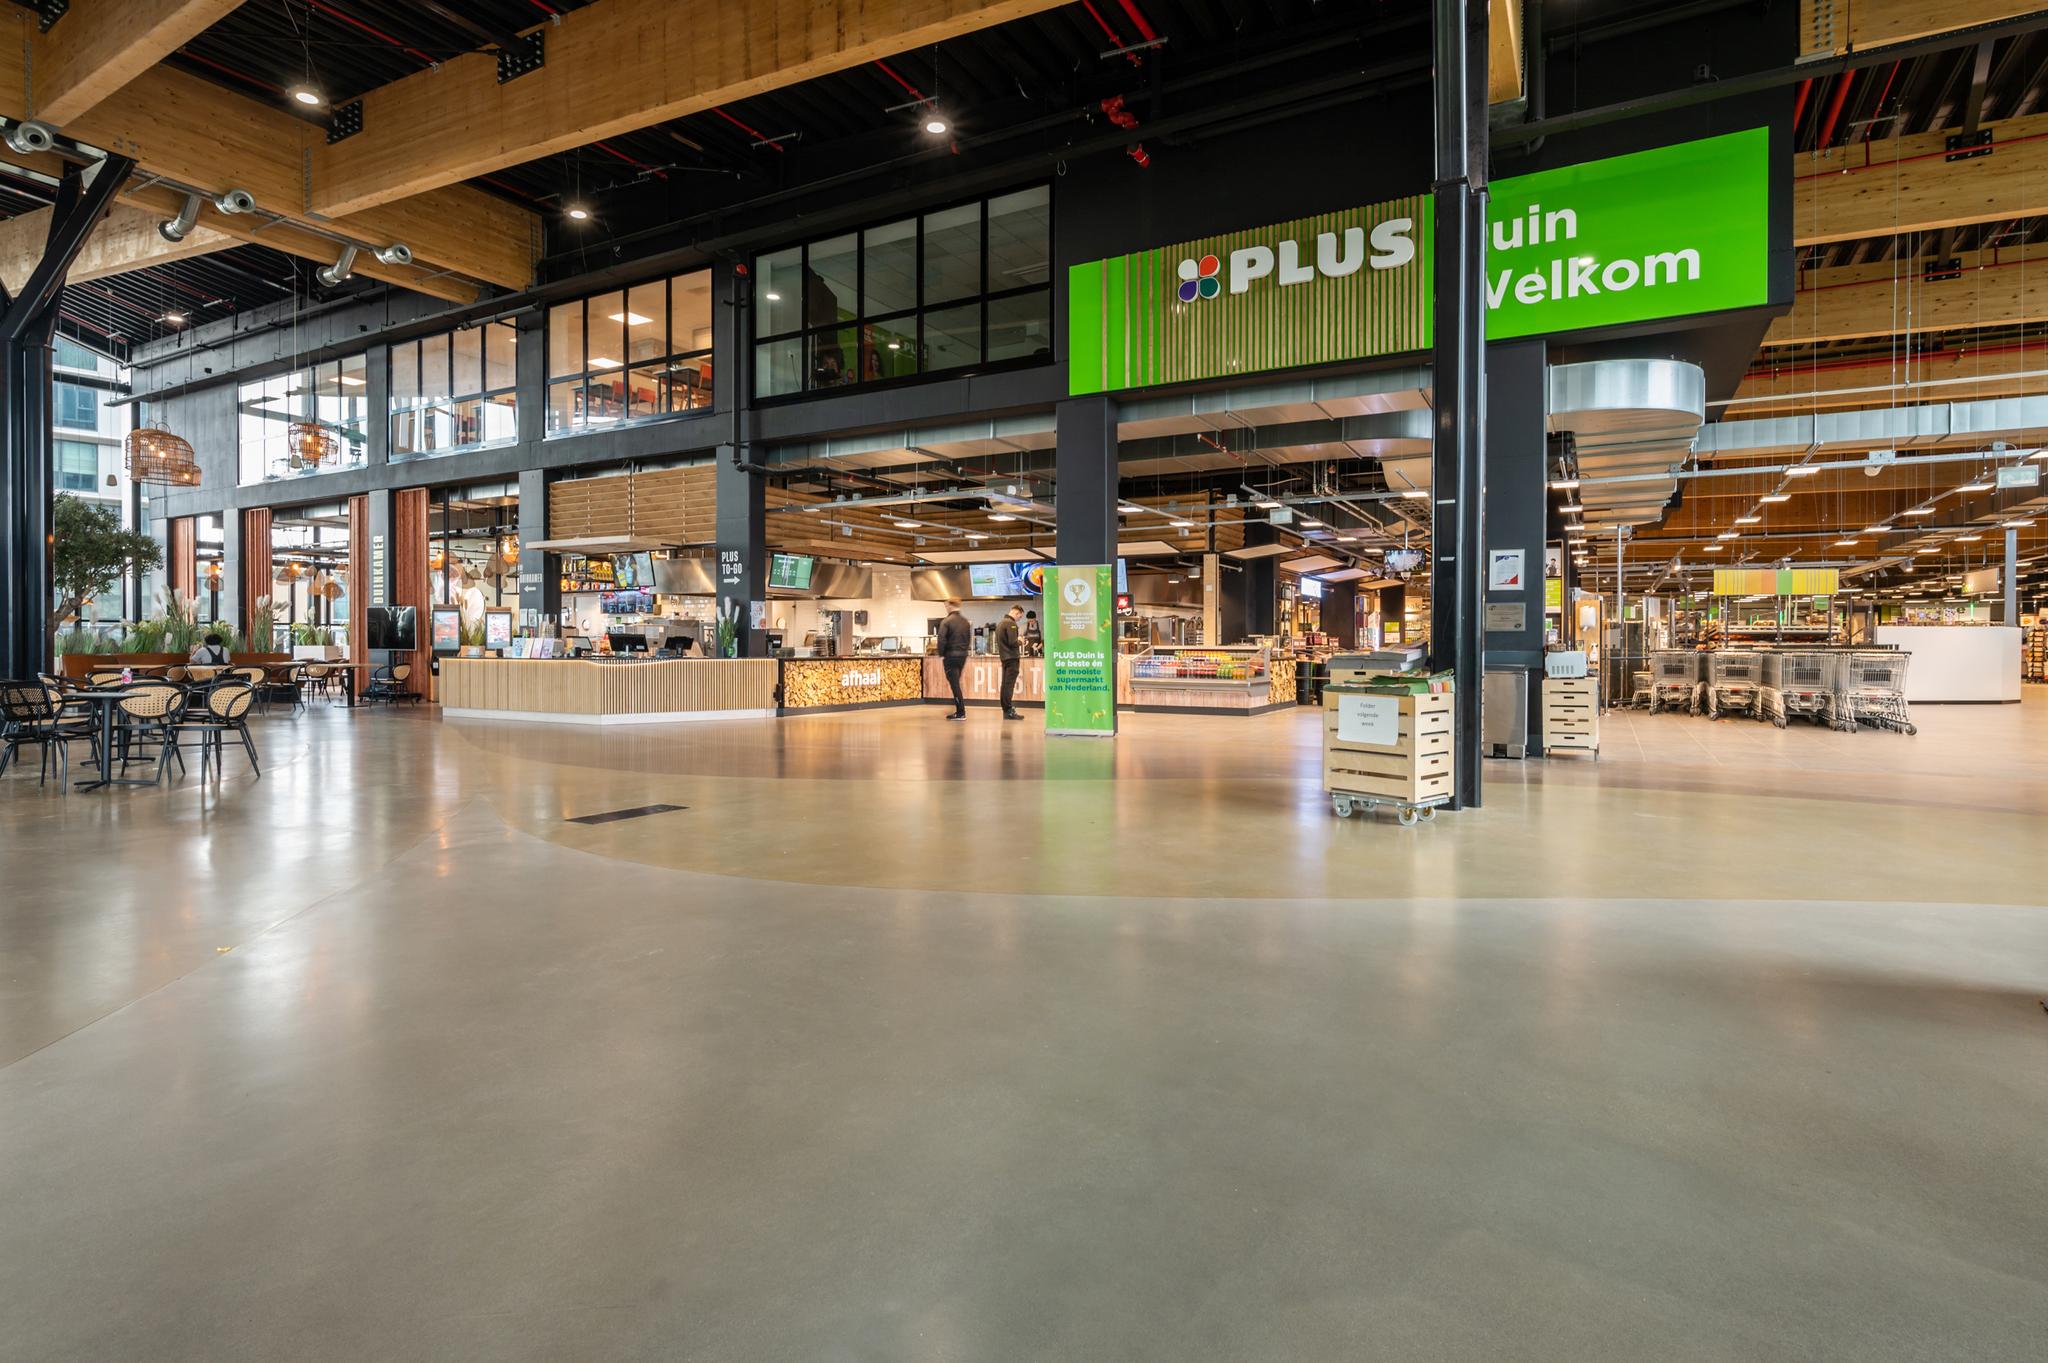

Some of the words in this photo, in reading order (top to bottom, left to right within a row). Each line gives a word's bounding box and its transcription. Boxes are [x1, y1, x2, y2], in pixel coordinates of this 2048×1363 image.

[1486, 204, 1577, 251] uin
[1230, 217, 1415, 295] PLUS
[722, 551, 739, 562] PLUS
[373, 536, 384, 604] DUINKAMER
[722, 563, 743, 575] TO-GO
[841, 669, 881, 687] afhaal
[1056, 676, 1104, 684] supermarkt
